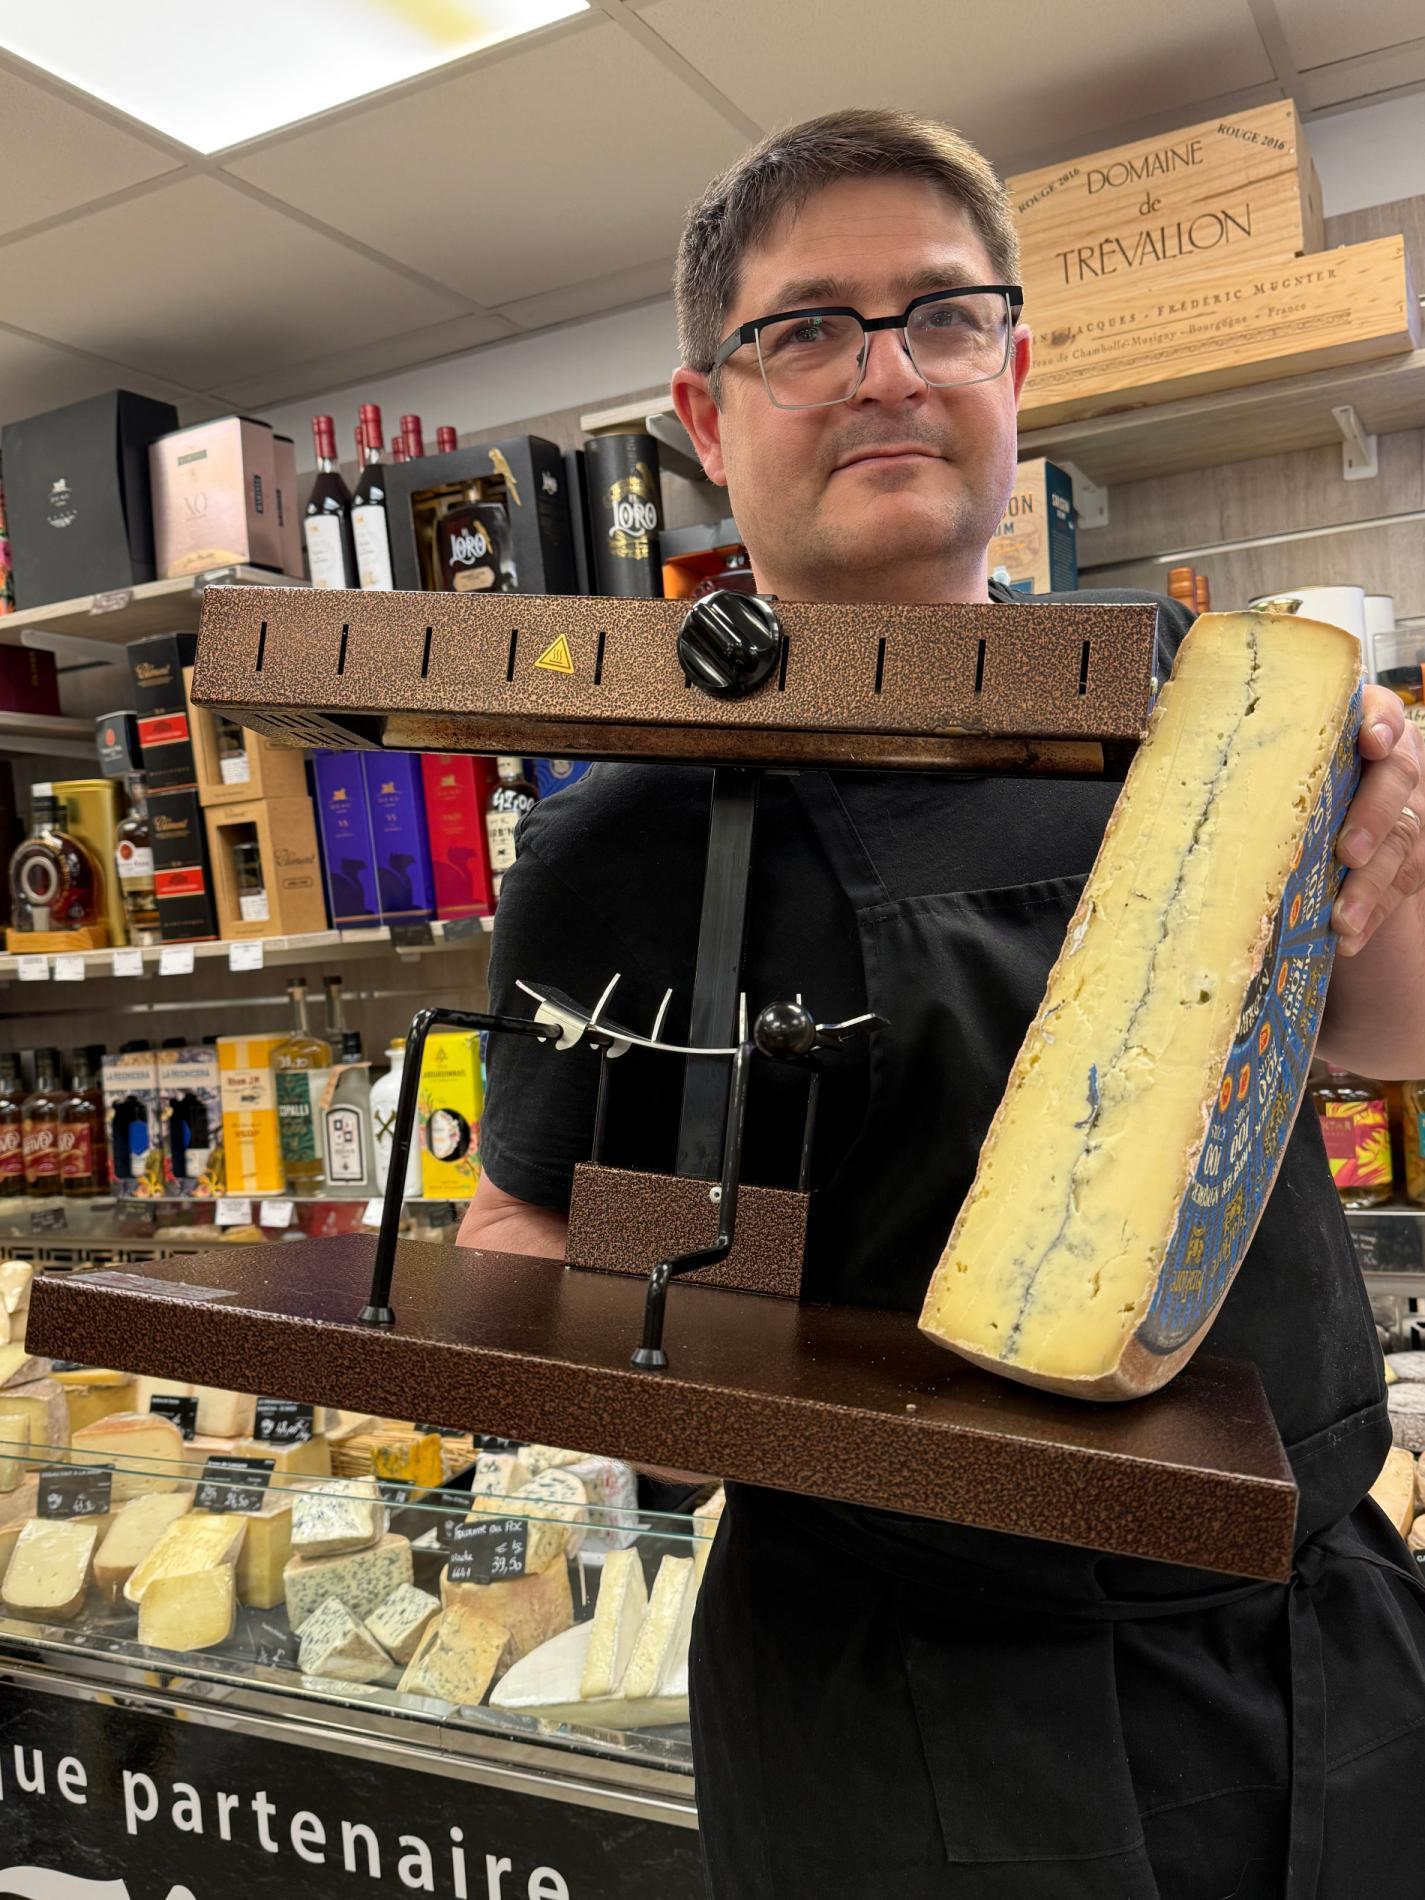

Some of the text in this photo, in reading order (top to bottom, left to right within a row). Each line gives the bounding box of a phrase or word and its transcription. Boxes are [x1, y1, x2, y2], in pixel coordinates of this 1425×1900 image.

[1217, 123, 1285, 151] ROUGE 2016
[1087, 140, 1204, 195] DOMAINE
[1018, 167, 1080, 213] ROUGE 2016
[1139, 192, 1162, 216] de
[1055, 202, 1251, 285] TRÉVALLON
[1268, 302, 1307, 318] France
[609, 501, 657, 538] LORO
[1003, 493, 1033, 518] ON
[449, 533, 487, 567] LORO
[491, 1556, 522, 1575] 39,50
[0, 1744, 571, 1900] ue partenaire
